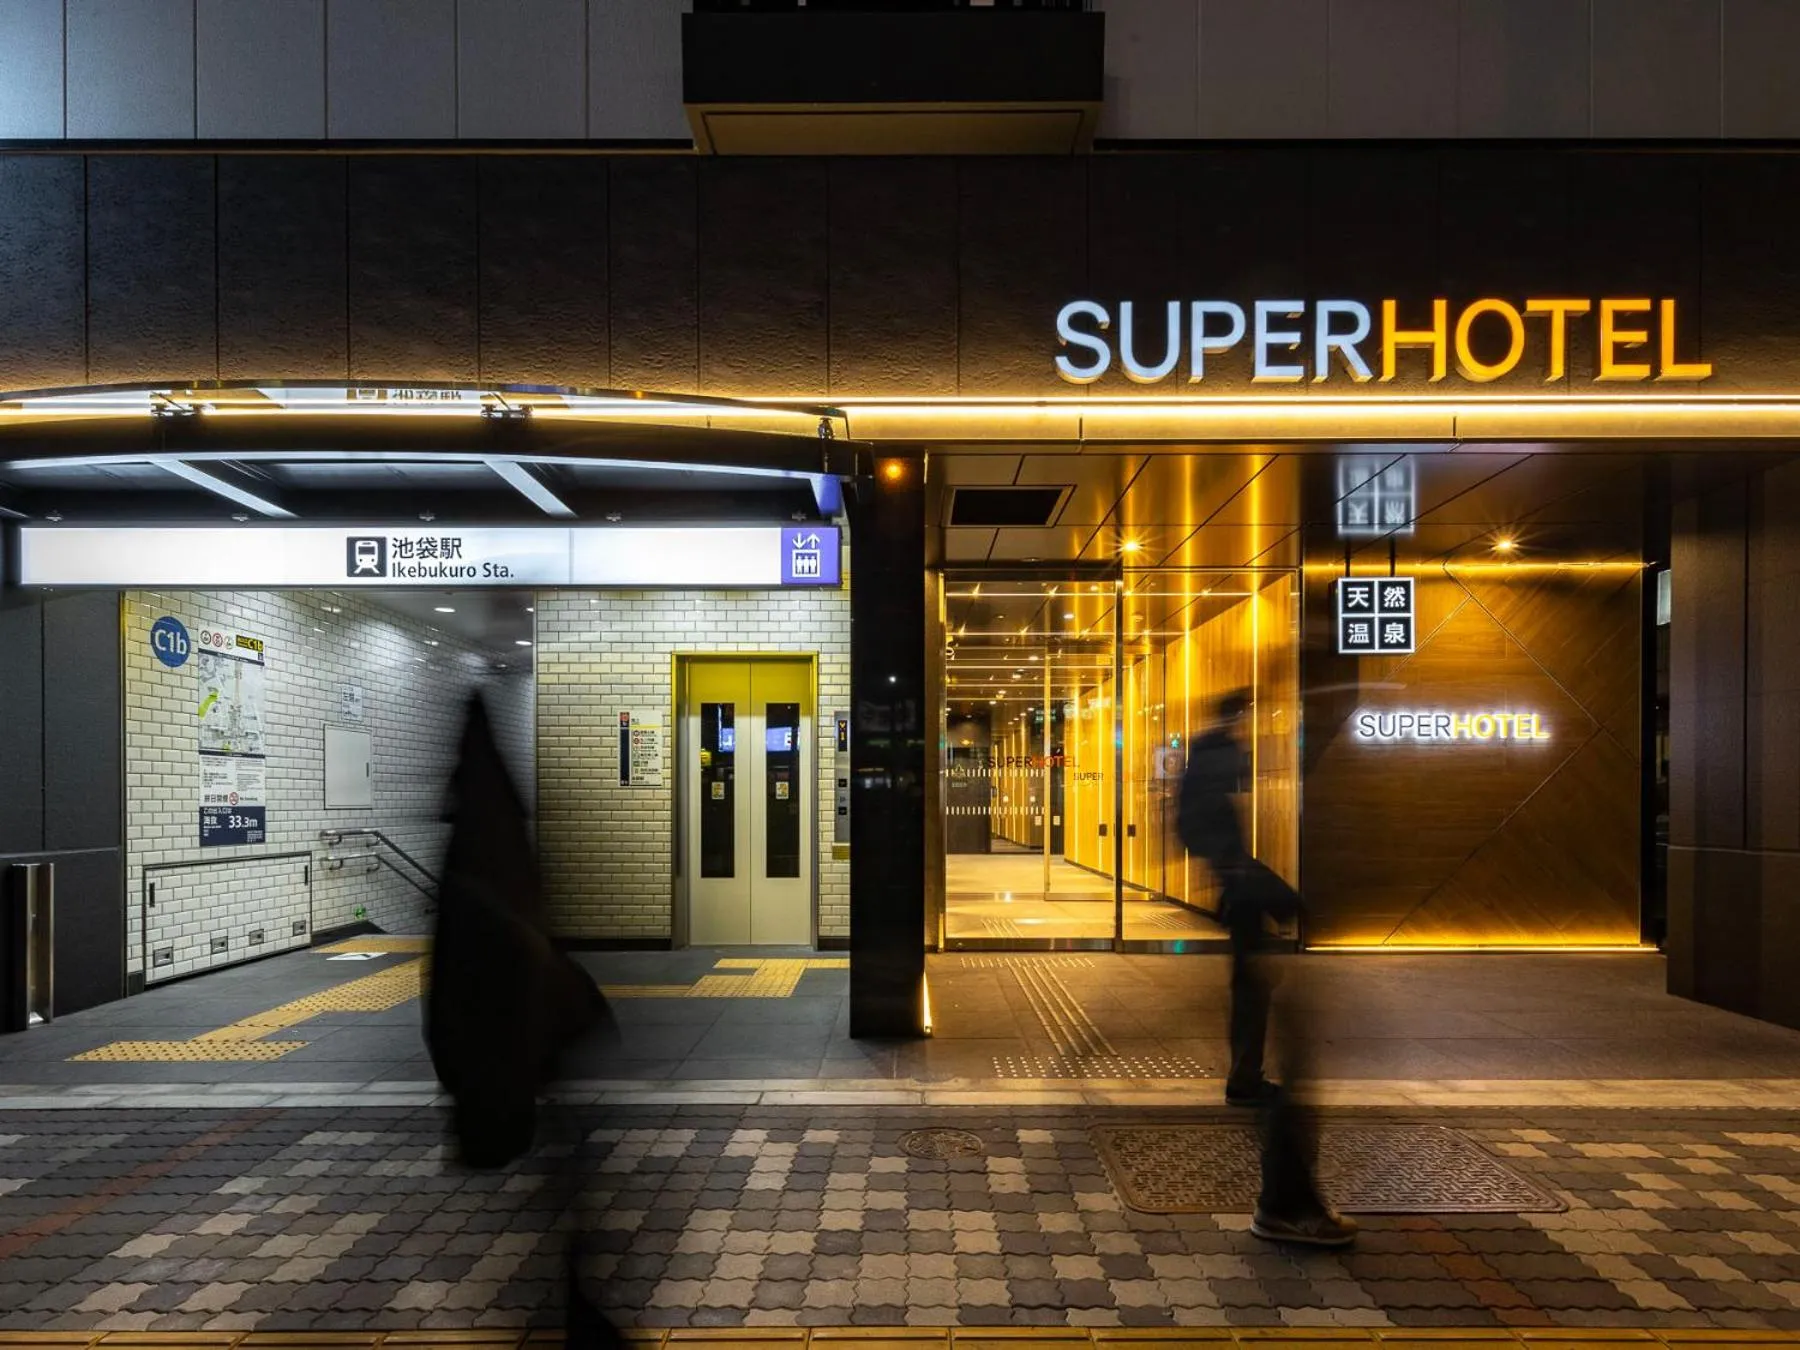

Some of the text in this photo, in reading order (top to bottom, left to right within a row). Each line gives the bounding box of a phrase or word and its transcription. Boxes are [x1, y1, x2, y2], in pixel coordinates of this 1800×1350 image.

[1054, 299, 1712, 382] SUPERHOTEL
[392, 537, 462, 560] 池袋駅
[392, 562, 514, 578] Ikebukuro Sta.
[1347, 586, 1406, 608] 天然
[155, 629, 187, 655] C1b
[1348, 622, 1406, 644] 温泉
[1359, 713, 1550, 739] SUPERHOTEL
[228, 815, 258, 829] 33.3m
